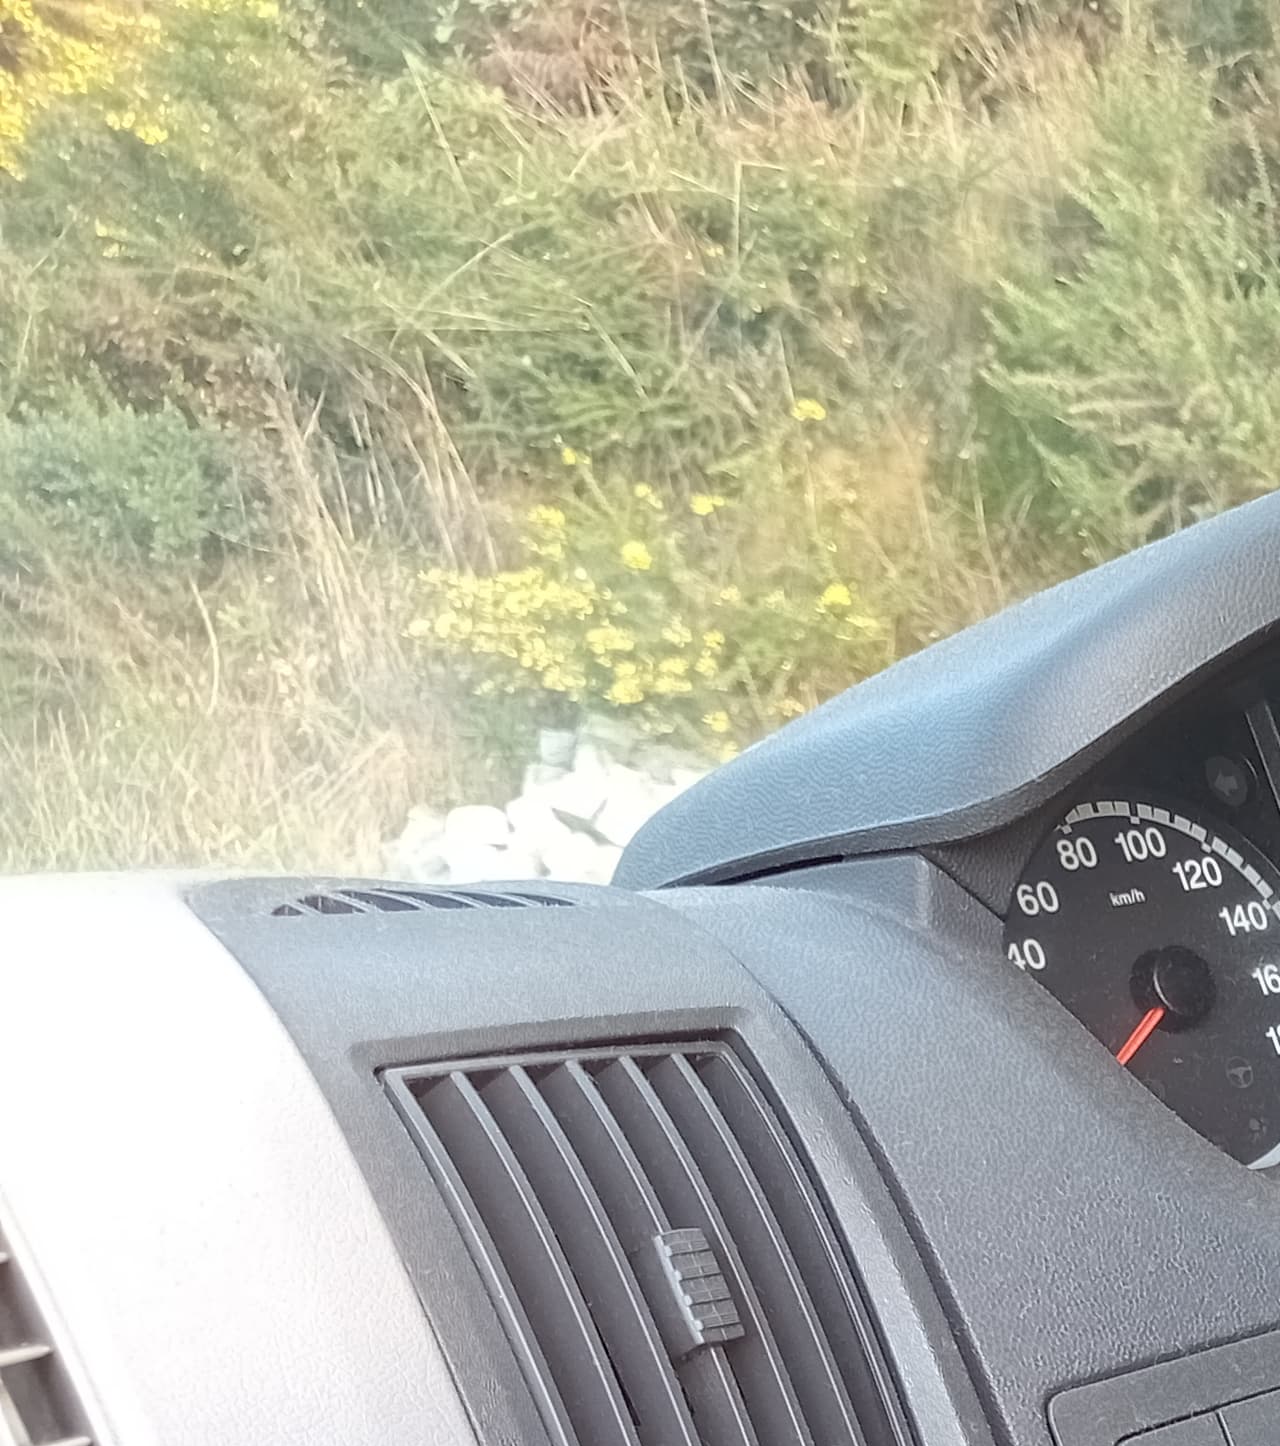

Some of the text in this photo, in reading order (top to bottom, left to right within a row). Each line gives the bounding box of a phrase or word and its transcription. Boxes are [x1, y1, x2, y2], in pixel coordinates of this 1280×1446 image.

[1056, 837, 1097, 870] 80
[1114, 827, 1166, 862] 100
[1172, 856, 1223, 891] 120
[1016, 881, 1059, 915] 60
[1109, 888, 1146, 907] km/h
[1219, 901, 1268, 936] 140
[1008, 938, 1046, 971] 40
